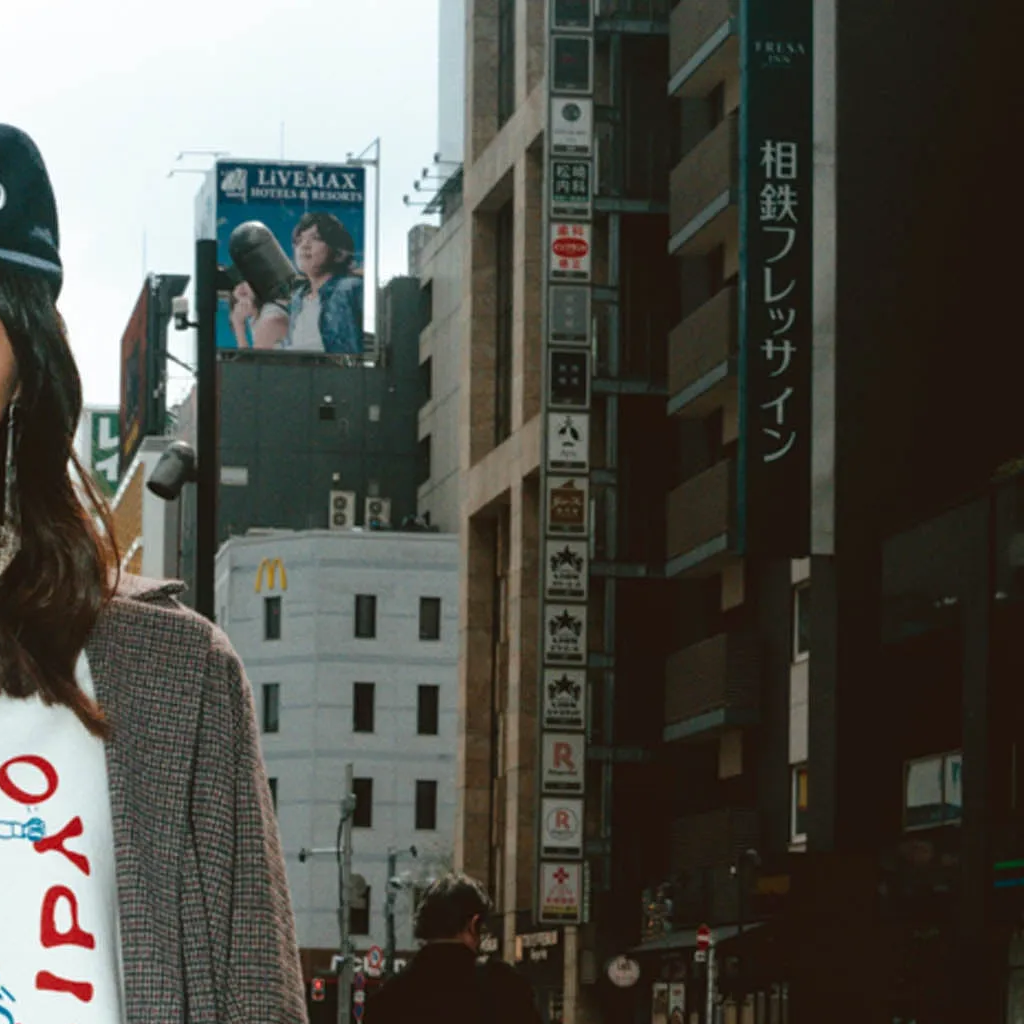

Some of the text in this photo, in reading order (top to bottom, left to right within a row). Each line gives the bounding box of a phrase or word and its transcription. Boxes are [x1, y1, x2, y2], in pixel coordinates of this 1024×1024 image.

[251, 186, 297, 199] HOTELS
[311, 190, 364, 203] RESORTS
[760, 139, 799, 463] 相鉄フレッサイン
